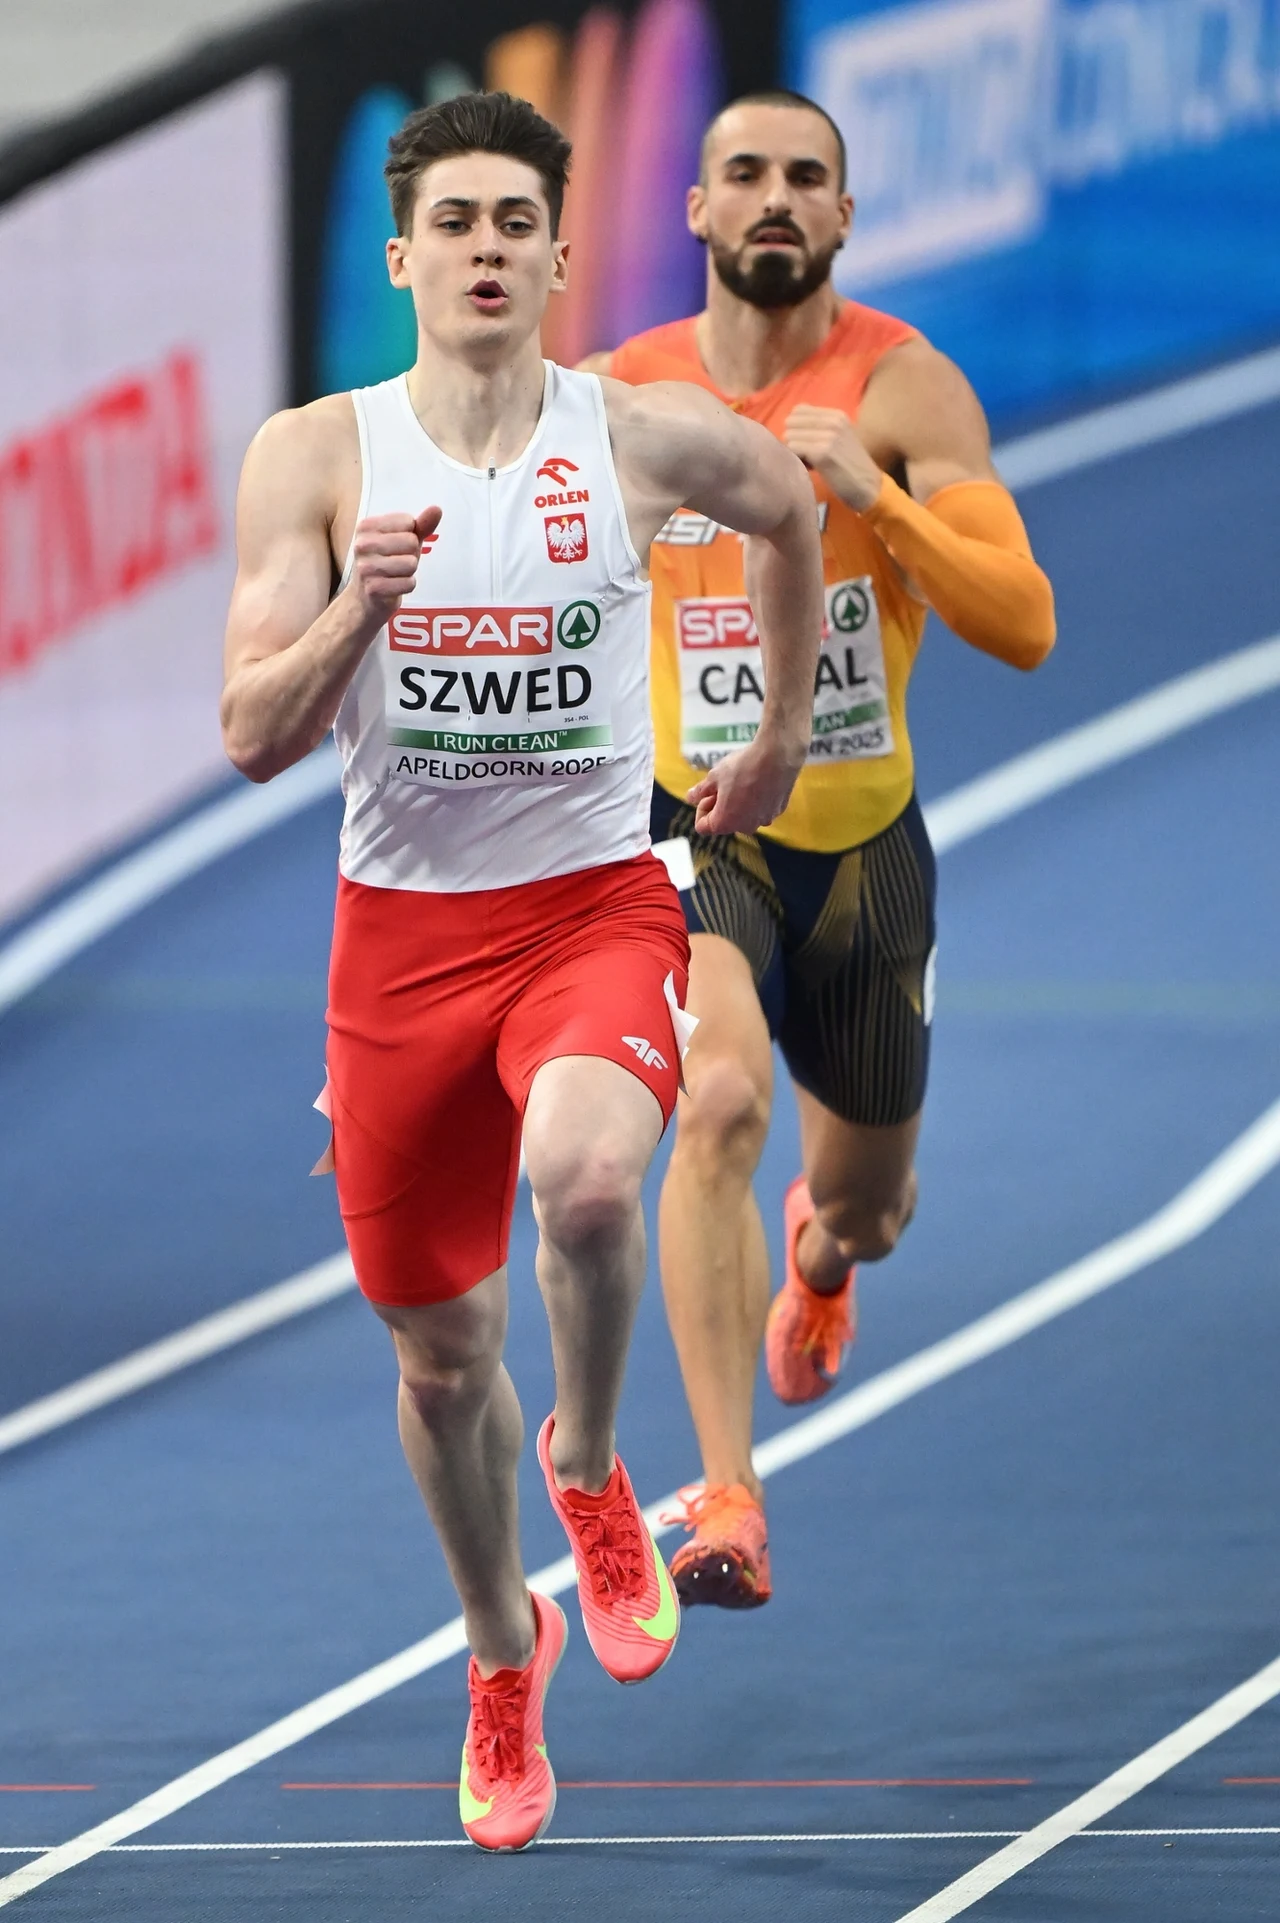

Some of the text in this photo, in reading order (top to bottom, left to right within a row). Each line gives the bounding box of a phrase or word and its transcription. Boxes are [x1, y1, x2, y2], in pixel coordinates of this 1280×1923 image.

[534, 489, 589, 508] ORLEN
[392, 613, 549, 649] SPAR
[399, 664, 592, 715] SZWED
[699, 647, 868, 705] CAAL
[434, 733, 438, 748] I
[443, 734, 486, 751] RUN
[396, 755, 544, 781] APELDOORN
